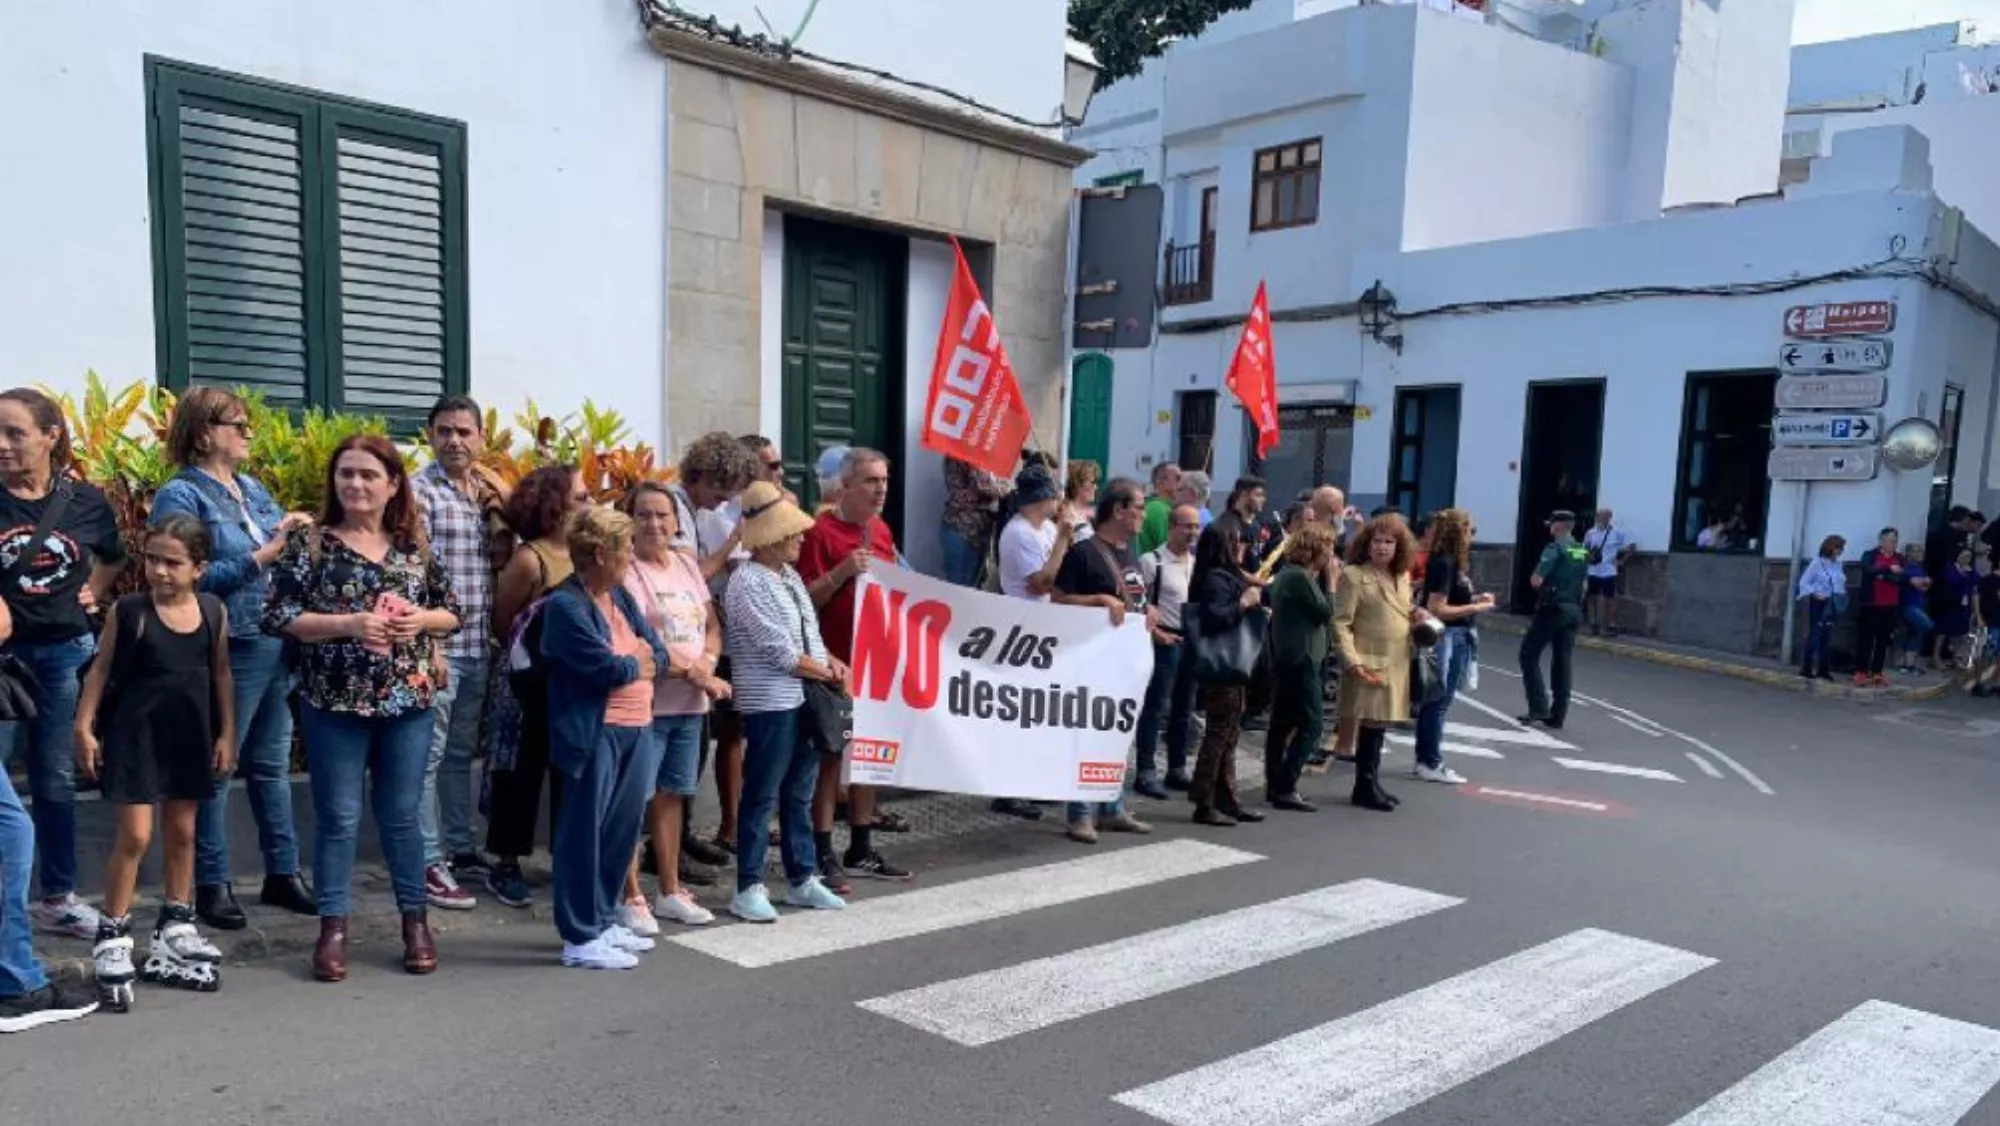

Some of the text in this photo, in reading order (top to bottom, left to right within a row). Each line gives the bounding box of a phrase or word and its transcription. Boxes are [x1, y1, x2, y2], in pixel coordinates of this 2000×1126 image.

[853, 582, 1058, 709] NO a los
[948, 669, 1137, 732] despidos
